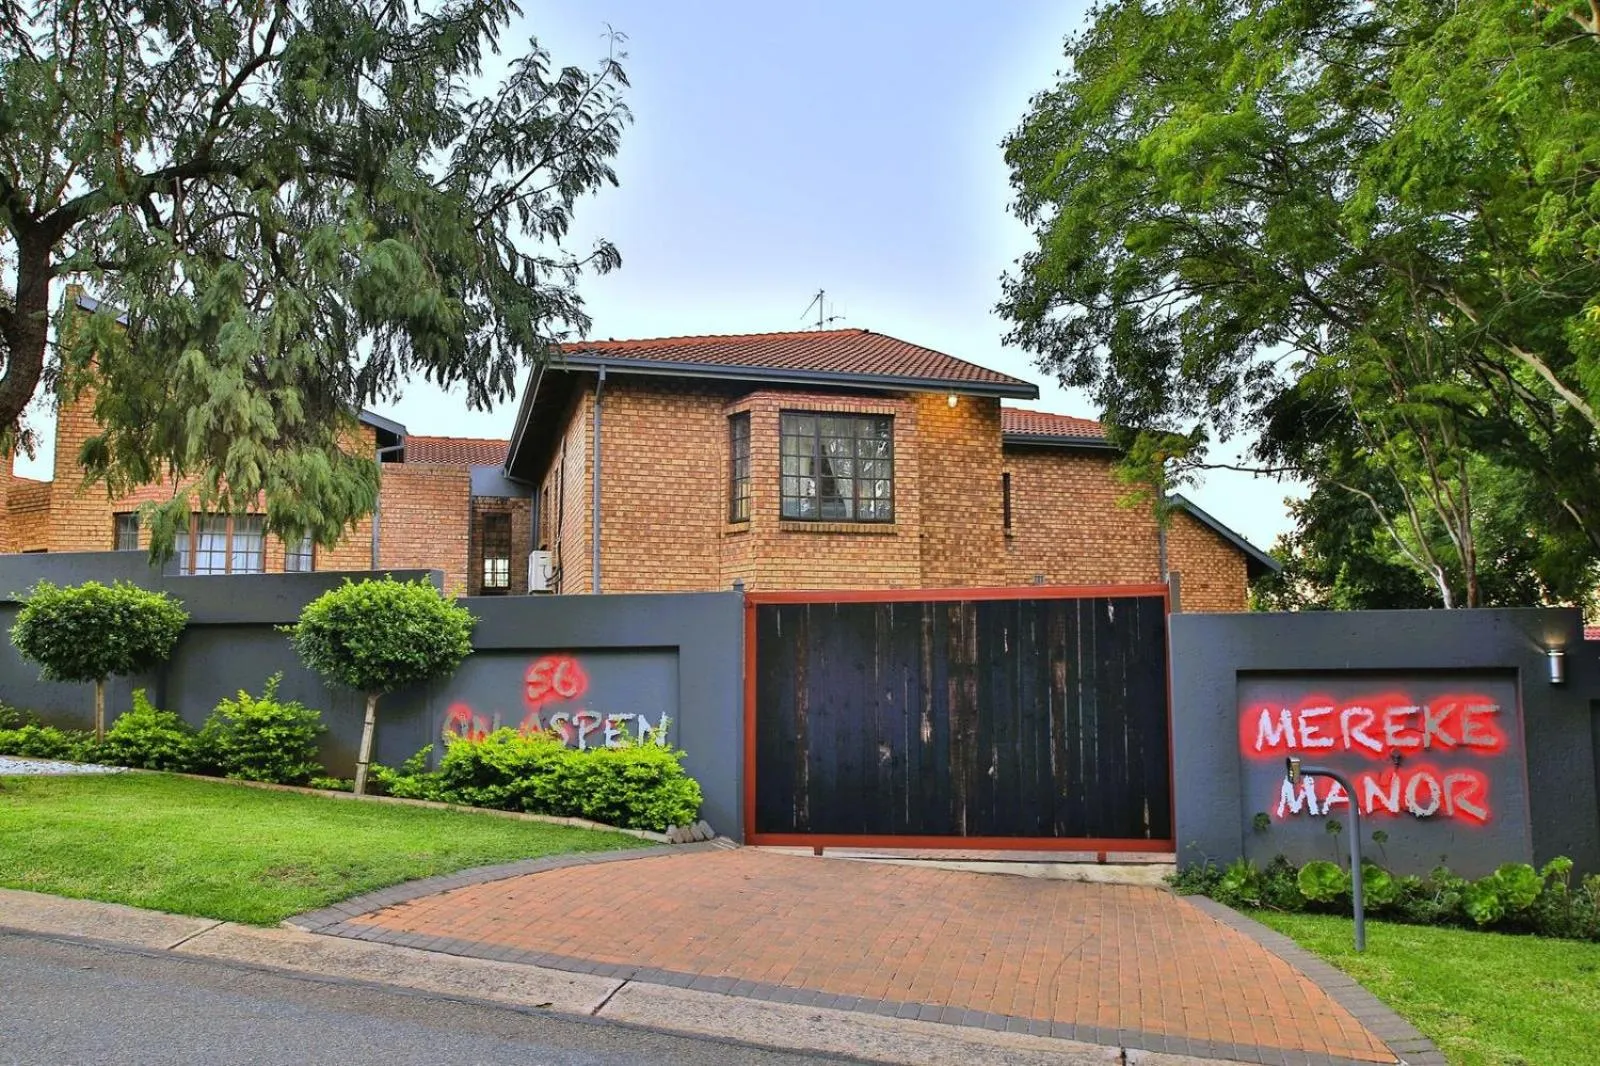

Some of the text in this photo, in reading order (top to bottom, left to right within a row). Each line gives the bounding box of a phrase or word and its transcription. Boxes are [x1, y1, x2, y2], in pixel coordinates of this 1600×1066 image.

[526, 660, 577, 699] 56
[522, 711, 669, 750] ASPEN
[1256, 703, 1500, 751] MEREKE
[1277, 771, 1487, 820] MANOR
